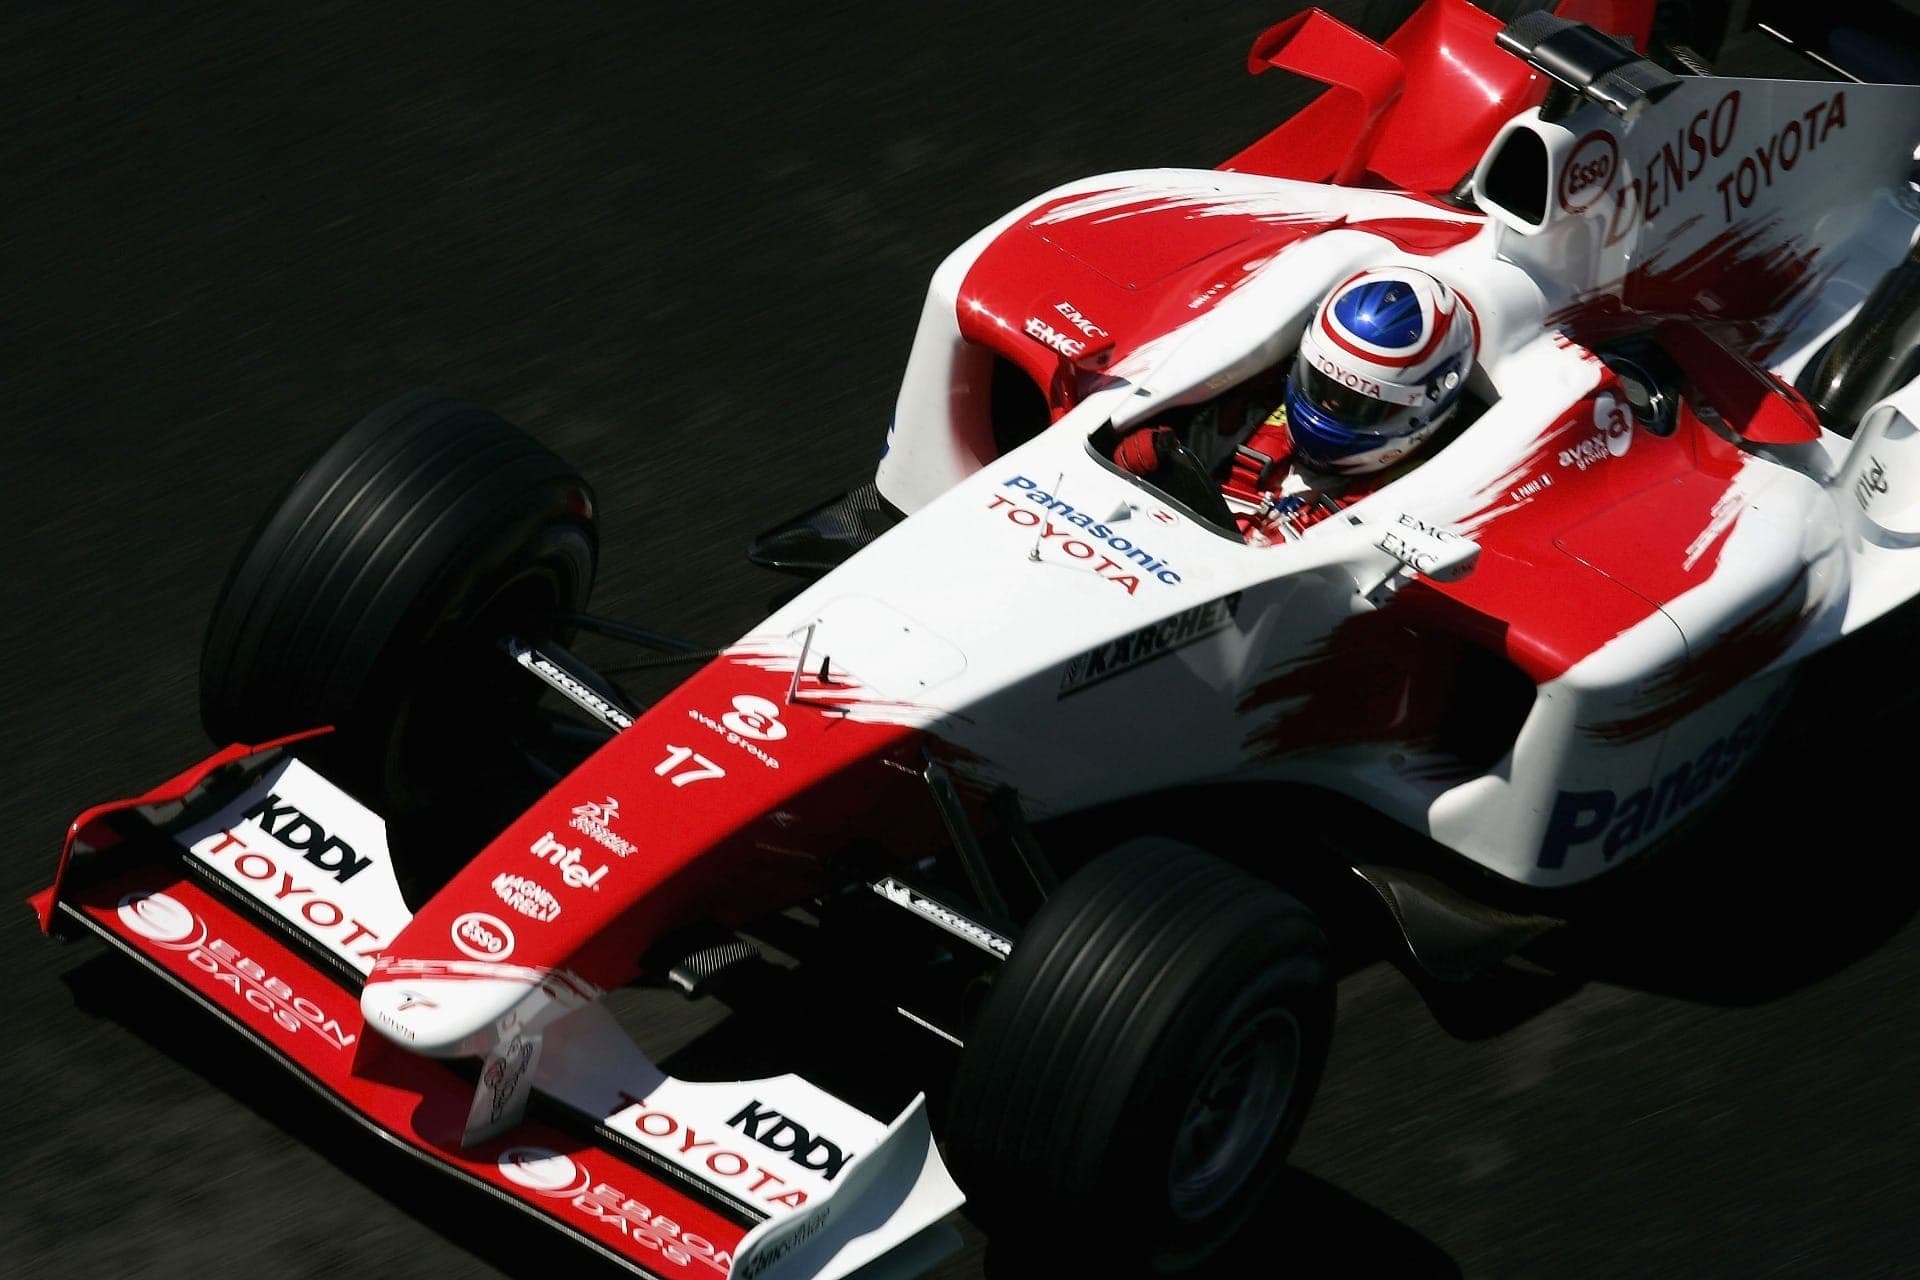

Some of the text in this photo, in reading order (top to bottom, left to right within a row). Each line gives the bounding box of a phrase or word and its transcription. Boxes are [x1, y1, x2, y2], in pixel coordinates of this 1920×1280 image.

[1605, 90, 1741, 248] DENSO
[1717, 91, 1847, 222] TOYOTA
[1316, 355, 1381, 399] TOYOTA
[988, 494, 1140, 596] TOYOTA
[1003, 475, 1182, 585] Panasonic
[654, 744, 726, 787] 17
[688, 710, 727, 735] avex
[242, 794, 373, 883] KDDI
[187, 949, 302, 1033] DACS
[209, 938, 356, 1047] EBBON
[725, 1099, 854, 1181] KDDI
[572, 1194, 692, 1266] DACS
